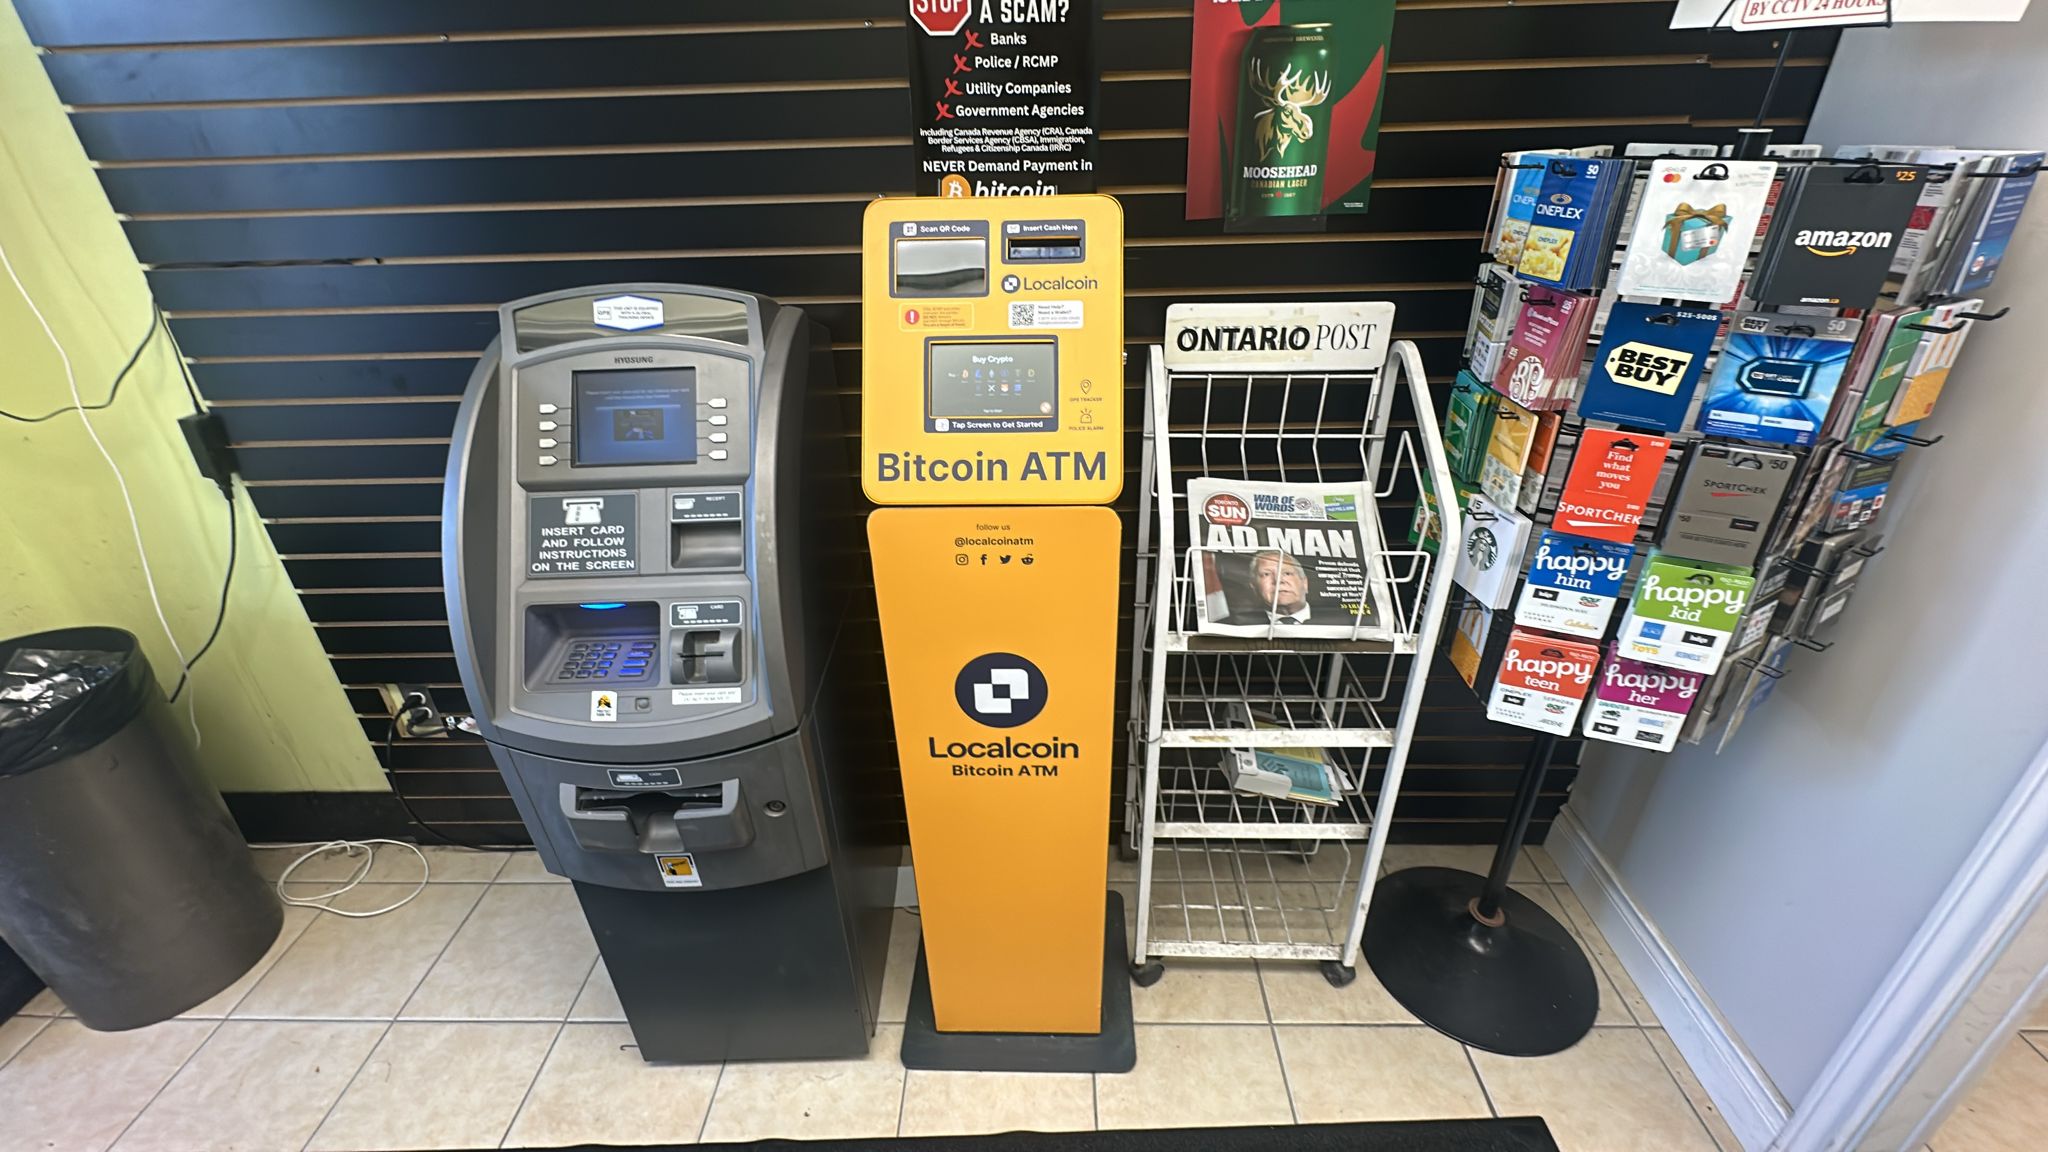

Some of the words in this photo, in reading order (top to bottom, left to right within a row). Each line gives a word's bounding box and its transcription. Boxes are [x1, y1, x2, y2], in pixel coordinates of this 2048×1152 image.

[979, 0, 993, 23] A
[1000, 0, 1070, 23] SCAM?
[1749, 2, 1769, 16] BY
[990, 32, 1027, 46] Banks
[974, 56, 1012, 69] Police
[1023, 55, 1058, 68] RCMP
[965, 82, 1002, 97] Utility
[1005, 82, 1072, 96] Companies
[955, 105, 1029, 117] Government
[1031, 104, 1085, 118] Agencies
[920, 128, 953, 137] Including
[954, 128, 980, 136] Canada
[981, 128, 1013, 136] Revenue
[1014, 127, 1040, 137] Agency
[1065, 127, 1093, 135] Canada
[928, 137, 952, 145] Border
[953, 136, 983, 145] Services
[984, 136, 1011, 146] Agency
[941, 145, 974, 154] Refugees
[981, 144, 1020, 153] Citizenship
[1021, 144, 1049, 152] Canada
[923, 160, 965, 172] NEVER
[968, 159, 1020, 172] Demand
[1023, 159, 1078, 174] Payment
[1080, 159, 1093, 171] in
[1243, 165, 1318, 178] MOOSEHEAD
[1586, 165, 1599, 175] 50
[1287, 179, 1308, 187] LAGER
[1896, 171, 1917, 181] $25
[1536, 204, 1584, 220] CINEPLEX
[920, 225, 938, 233] Scan
[940, 225, 950, 233] QR
[952, 225, 971, 233] Code
[1795, 230, 1893, 248] amazon
[1024, 276, 1098, 291] Localcoin
[1827, 320, 1846, 331] 50
[1176, 327, 1311, 352] ONTARIO
[1315, 323, 1377, 350] POST
[614, 356, 654, 364] HYOSUNG
[972, 355, 986, 364] Buy
[987, 355, 1014, 364] Crypto
[1618, 348, 1687, 374] BEST
[1614, 363, 1677, 386] BUY
[952, 421, 965, 429] Tap
[1607, 451, 1634, 462] Find
[878, 451, 1008, 481] Bitcoin
[1020, 451, 1106, 481] ATM
[1603, 461, 1631, 472] what
[1769, 460, 1788, 470] $50
[1596, 471, 1631, 481] moves
[1598, 480, 1620, 490] you
[1704, 479, 1768, 495] SPORTCHEK
[1254, 494, 1279, 503] WAR
[1281, 496, 1295, 504] OF
[1208, 504, 1247, 520] SUN
[1254, 503, 1295, 512] WORDS
[1557, 501, 1643, 525] SPORTCHEK
[541, 527, 585, 536] INSERT
[590, 525, 624, 535] CARD
[976, 523, 999, 531] follow
[542, 539, 567, 548] AND
[574, 537, 625, 547] FOLLOW
[954, 537, 1034, 547] @localcoinatm
[1207, 524, 1259, 553] AD
[1266, 527, 1357, 559] MAN
[539, 549, 627, 560] INSTRUCTIONS
[532, 562, 550, 572] ON
[556, 561, 580, 571] THE
[586, 560, 635, 570] SCREEN
[1535, 545, 1628, 581] happy
[1554, 572, 1591, 590] him
[1642, 575, 1746, 614] happy
[1669, 605, 1702, 622] kid
[1505, 649, 1593, 684] happy
[1524, 675, 1560, 691] teen
[1604, 663, 1698, 698] happy
[1628, 690, 1660, 705] her
[928, 736, 1079, 759] Localcoin
[952, 765, 1013, 777] Bitcoin
[1018, 765, 1058, 777] ATM
